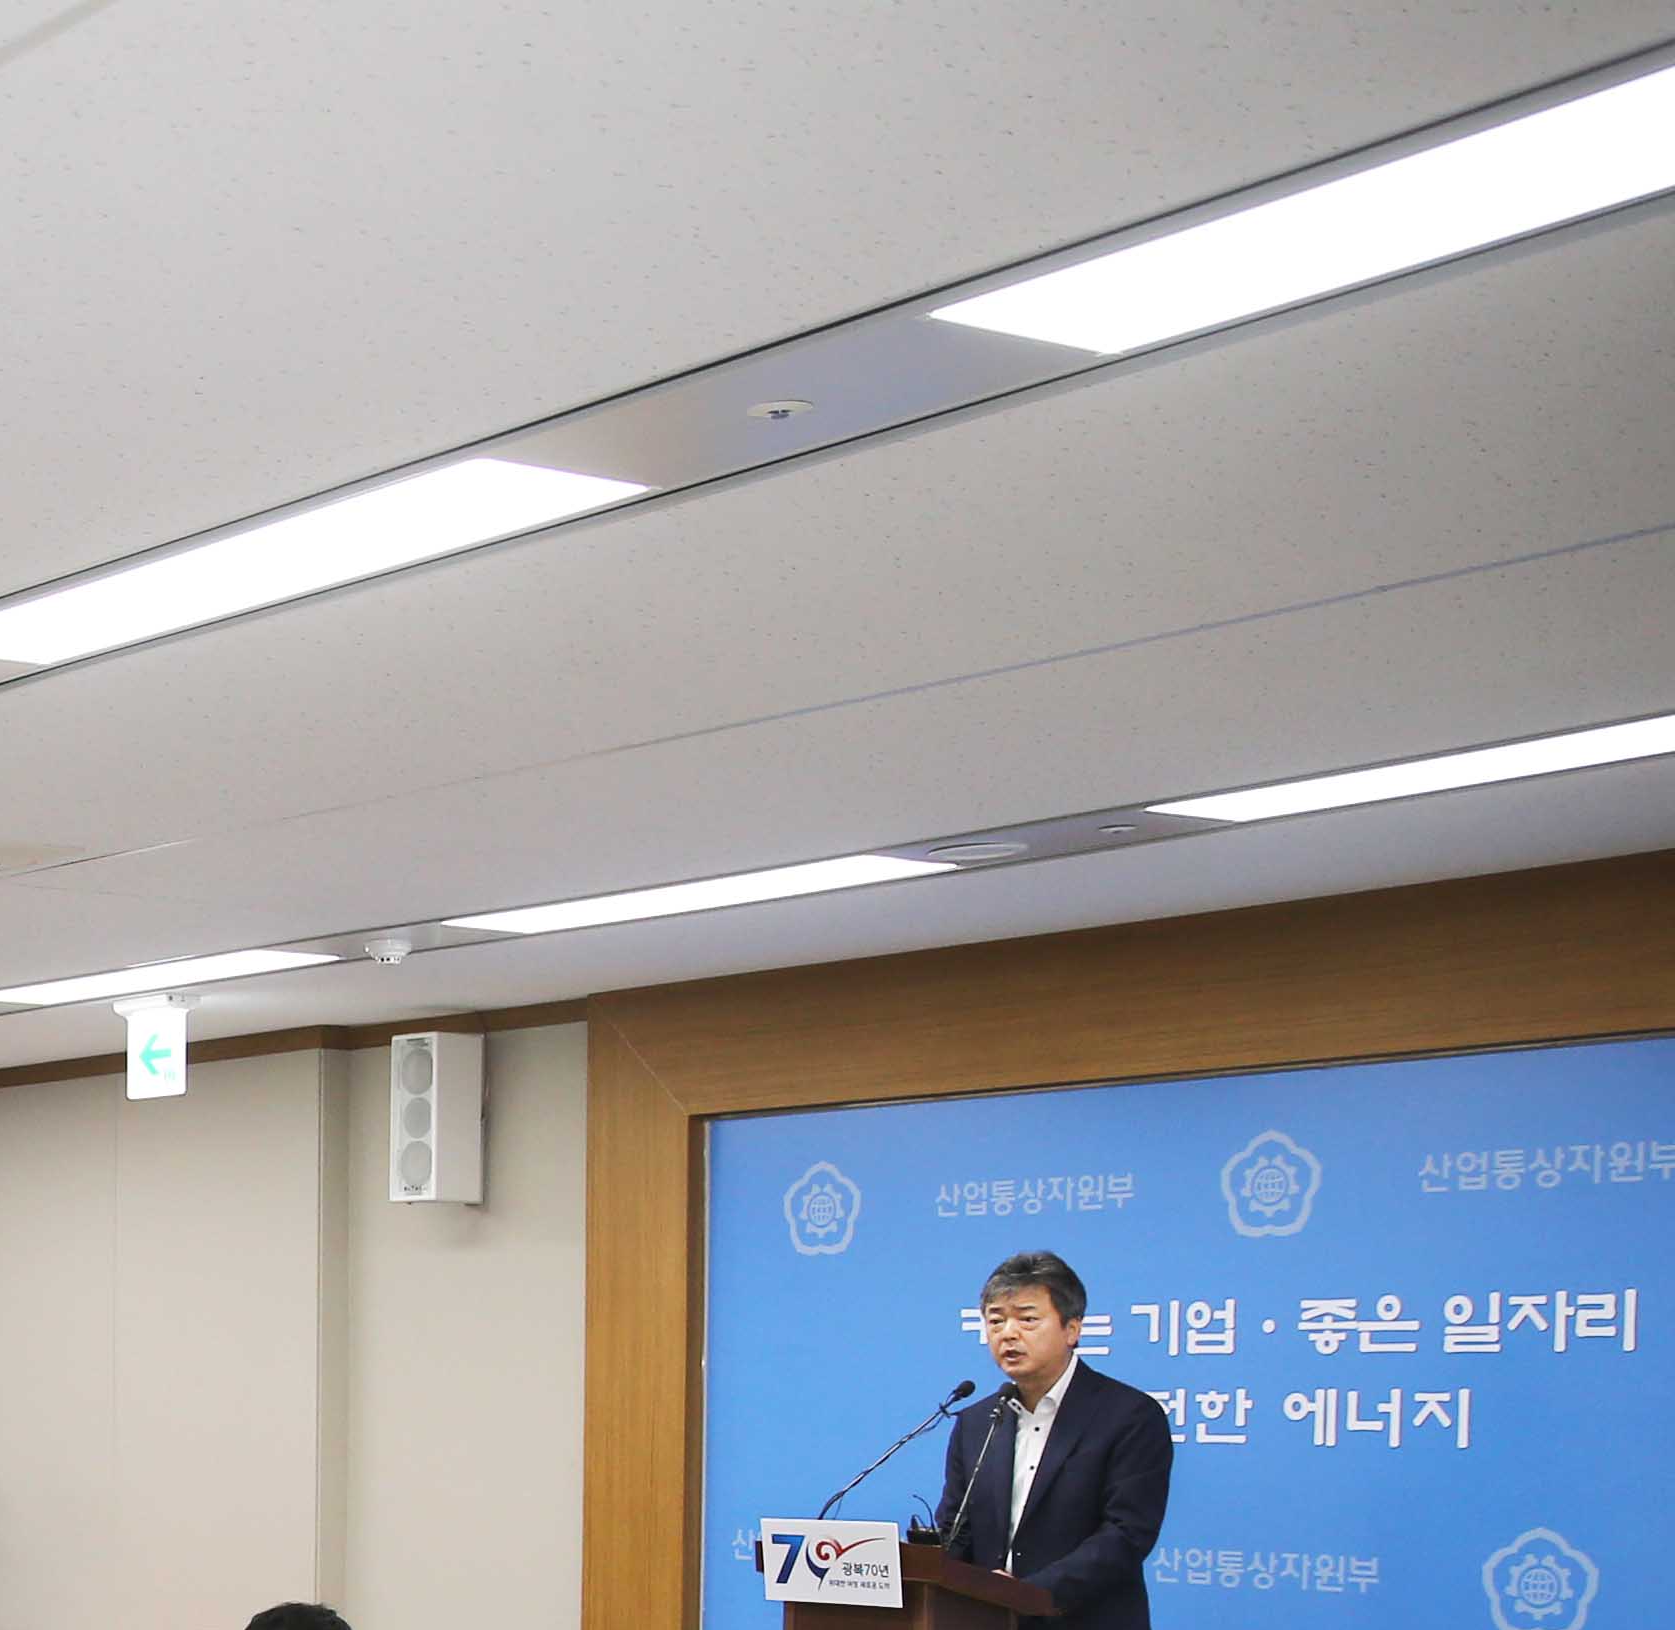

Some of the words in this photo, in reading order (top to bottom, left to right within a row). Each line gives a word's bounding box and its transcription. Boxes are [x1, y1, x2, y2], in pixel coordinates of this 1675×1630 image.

[1418, 1141, 1675, 1192] 산업통상자원부
[935, 1173, 1135, 1217] 산업통상자원부
[1131, 1298, 1236, 1356] 기업
[1299, 1295, 1420, 1355] 좋은
[1443, 1289, 1637, 1353] 일자리
[1145, 1388, 1253, 1443] 전한
[1284, 1388, 1472, 1448] 에너지
[842, 1562, 890, 1578] 광복70년
[1153, 1548, 1380, 1593] 산업통상자원부
